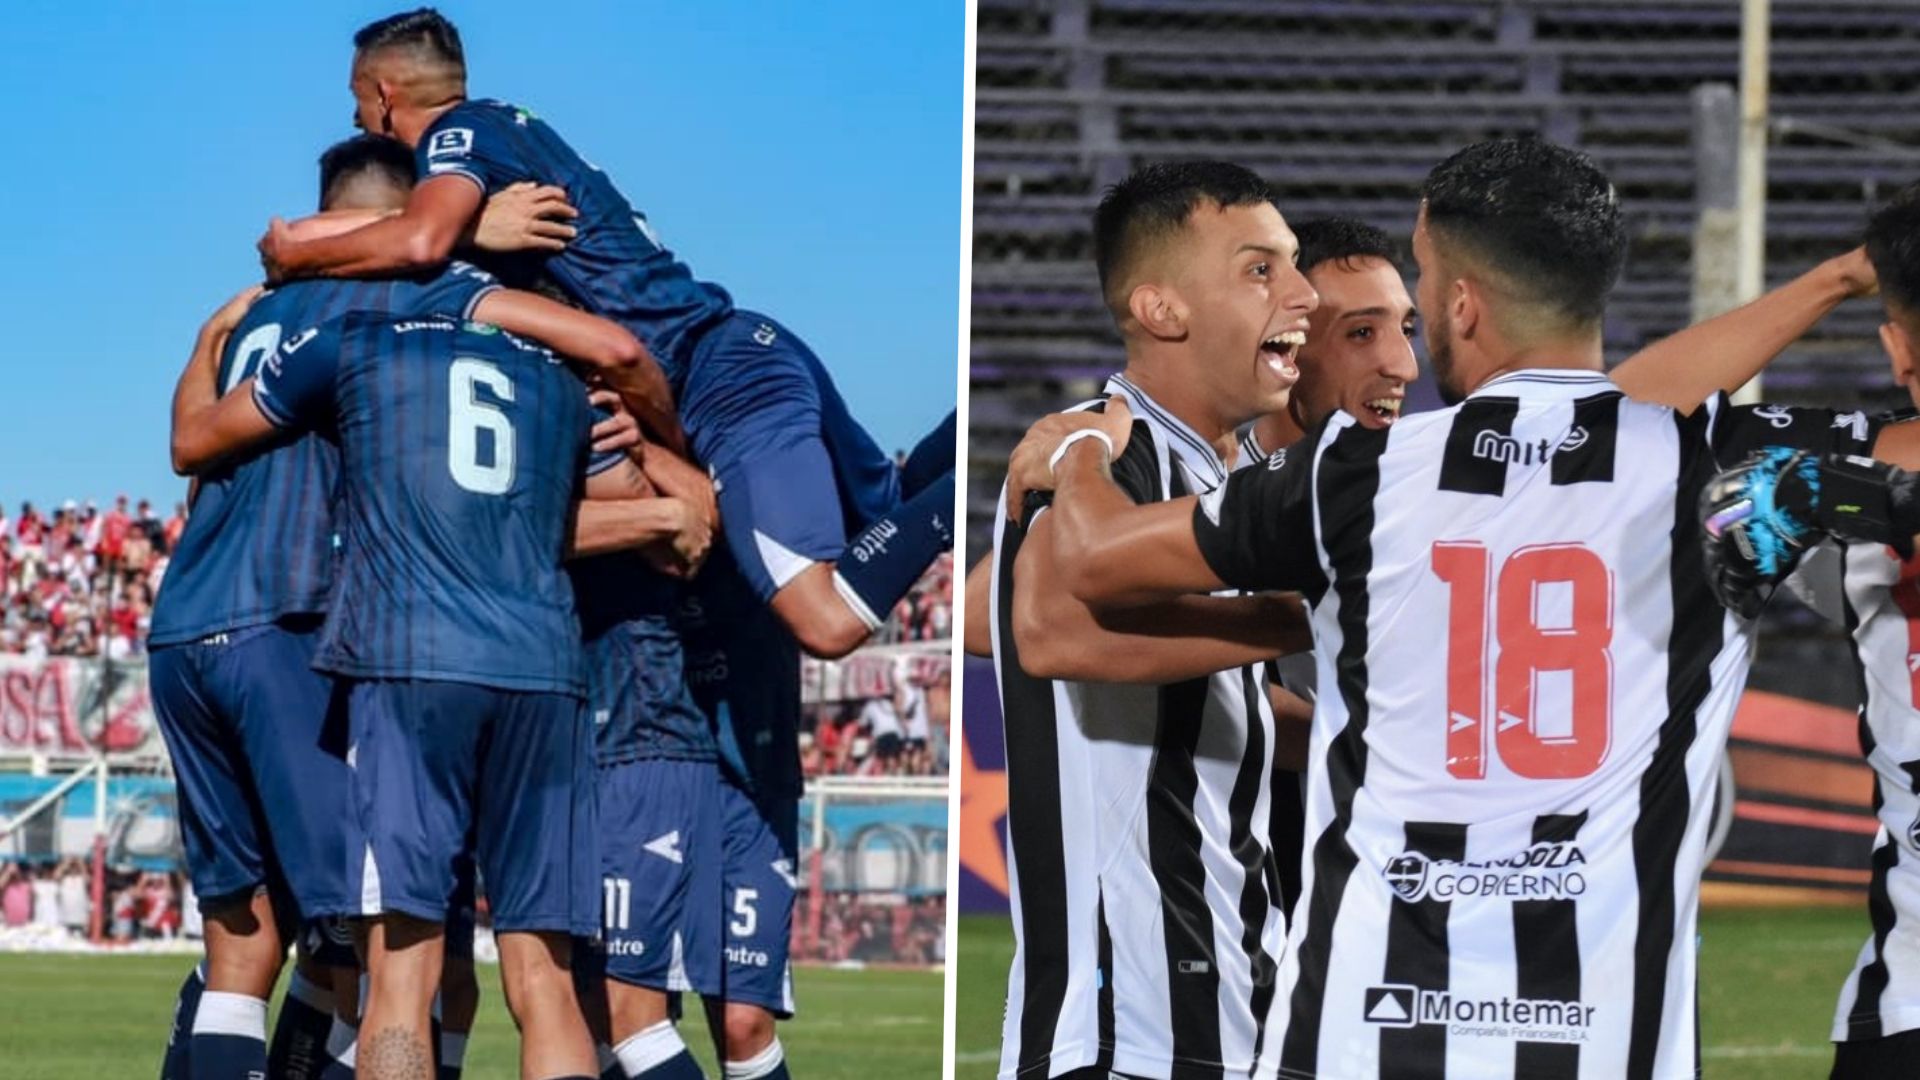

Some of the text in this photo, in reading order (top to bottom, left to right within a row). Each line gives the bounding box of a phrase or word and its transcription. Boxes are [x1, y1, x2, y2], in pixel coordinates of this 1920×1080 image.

[449, 357, 516, 495] 6
[1473, 428, 1590, 467] mite
[852, 518, 898, 562] mitre
[1431, 540, 1614, 780] 18
[603, 878, 631, 930] 11
[1434, 872, 1587, 897] GOBIERNO
[730, 888, 758, 937] 5
[605, 937, 645, 956] itre
[1424, 994, 1596, 1027] Montemar
